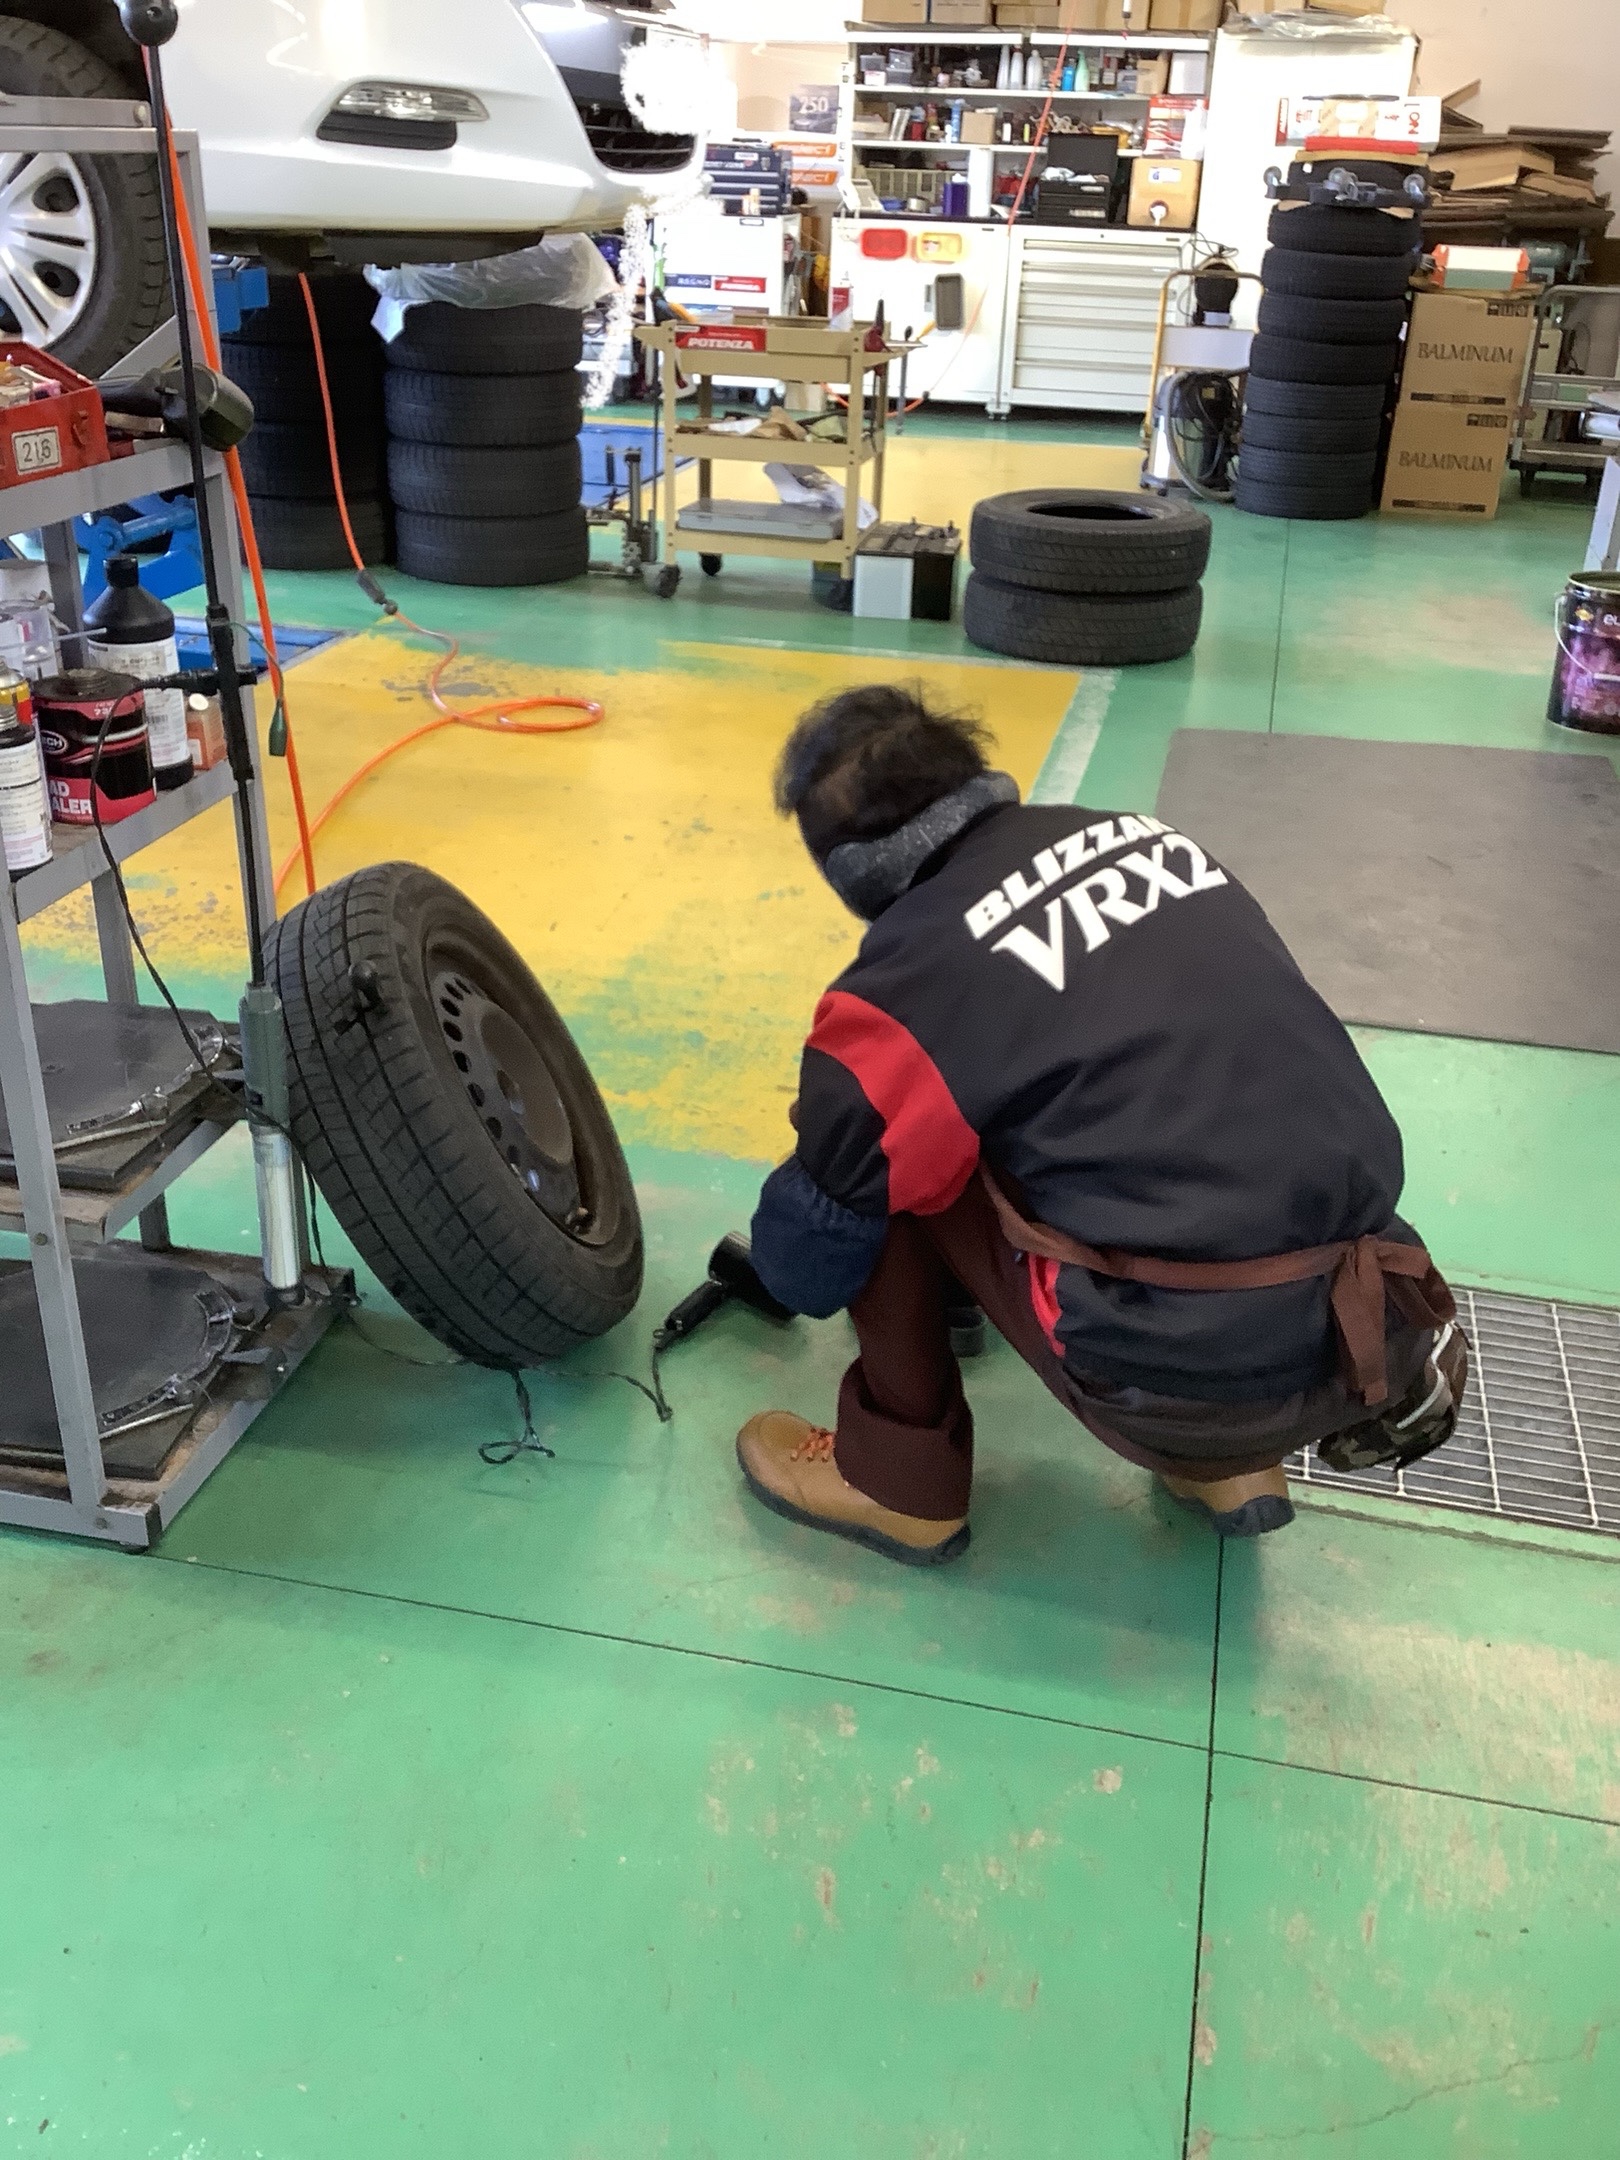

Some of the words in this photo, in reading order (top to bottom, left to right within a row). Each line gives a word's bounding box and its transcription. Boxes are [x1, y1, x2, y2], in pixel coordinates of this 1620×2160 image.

[687, 337, 755, 350] POTENZA
[1417, 342, 1514, 364] BALMINUM
[1399, 450, 1493, 473] BALMINUM
[990, 832, 1229, 993] VRX2
